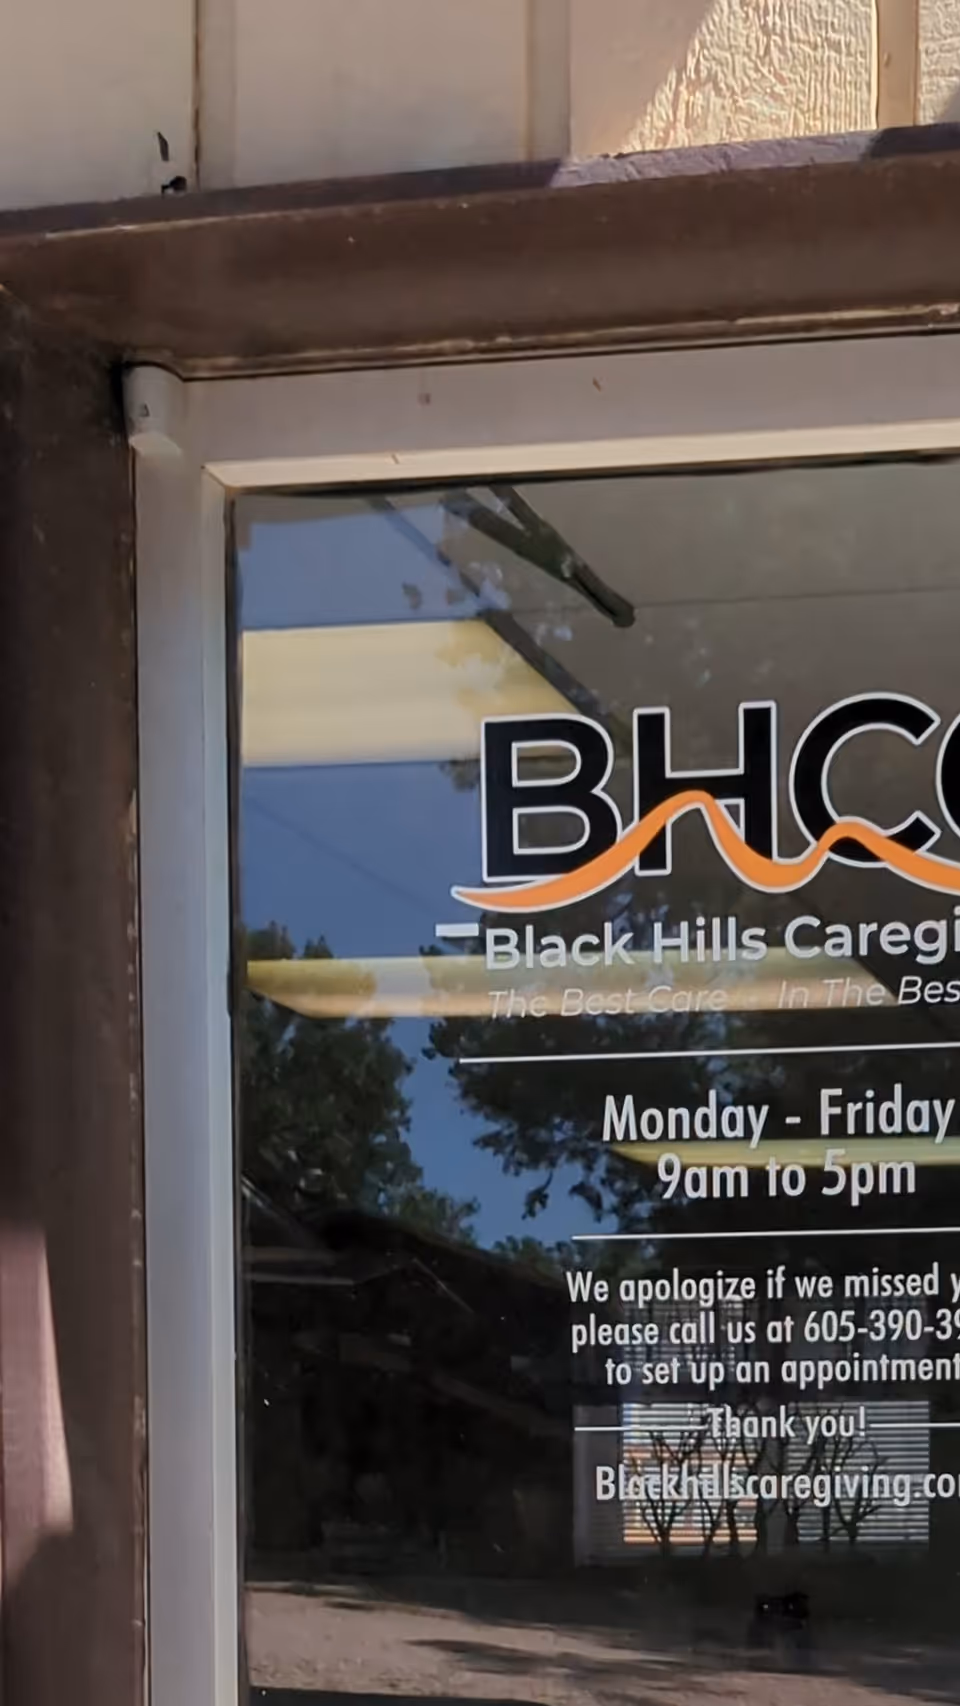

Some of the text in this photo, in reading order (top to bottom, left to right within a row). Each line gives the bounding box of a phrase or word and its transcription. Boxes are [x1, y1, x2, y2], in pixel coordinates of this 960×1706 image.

[484, 923, 633, 971] Black
[652, 917, 767, 964] Hills
[487, 988, 547, 1019] The
[560, 987, 635, 1017] Best
[778, 979, 809, 1009] In
[821, 977, 886, 1007] The
[602, 1089, 769, 1148] Monday
[785, 1116, 802, 1125] -
[658, 1148, 917, 1206] 9am to 5pm
[566, 1271, 609, 1303] We
[619, 1267, 756, 1308] apologize
[766, 1265, 786, 1298] if
[795, 1274, 834, 1298] we
[844, 1262, 940, 1297] missed
[571, 1313, 660, 1353] please
[669, 1312, 715, 1345] call
[727, 1320, 757, 1343] us
[766, 1316, 794, 1343] at
[605, 1358, 632, 1385] to
[642, 1357, 681, 1384] set
[690, 1361, 725, 1390] up
[736, 1360, 770, 1384] an
[706, 1405, 867, 1444] Thank you!
